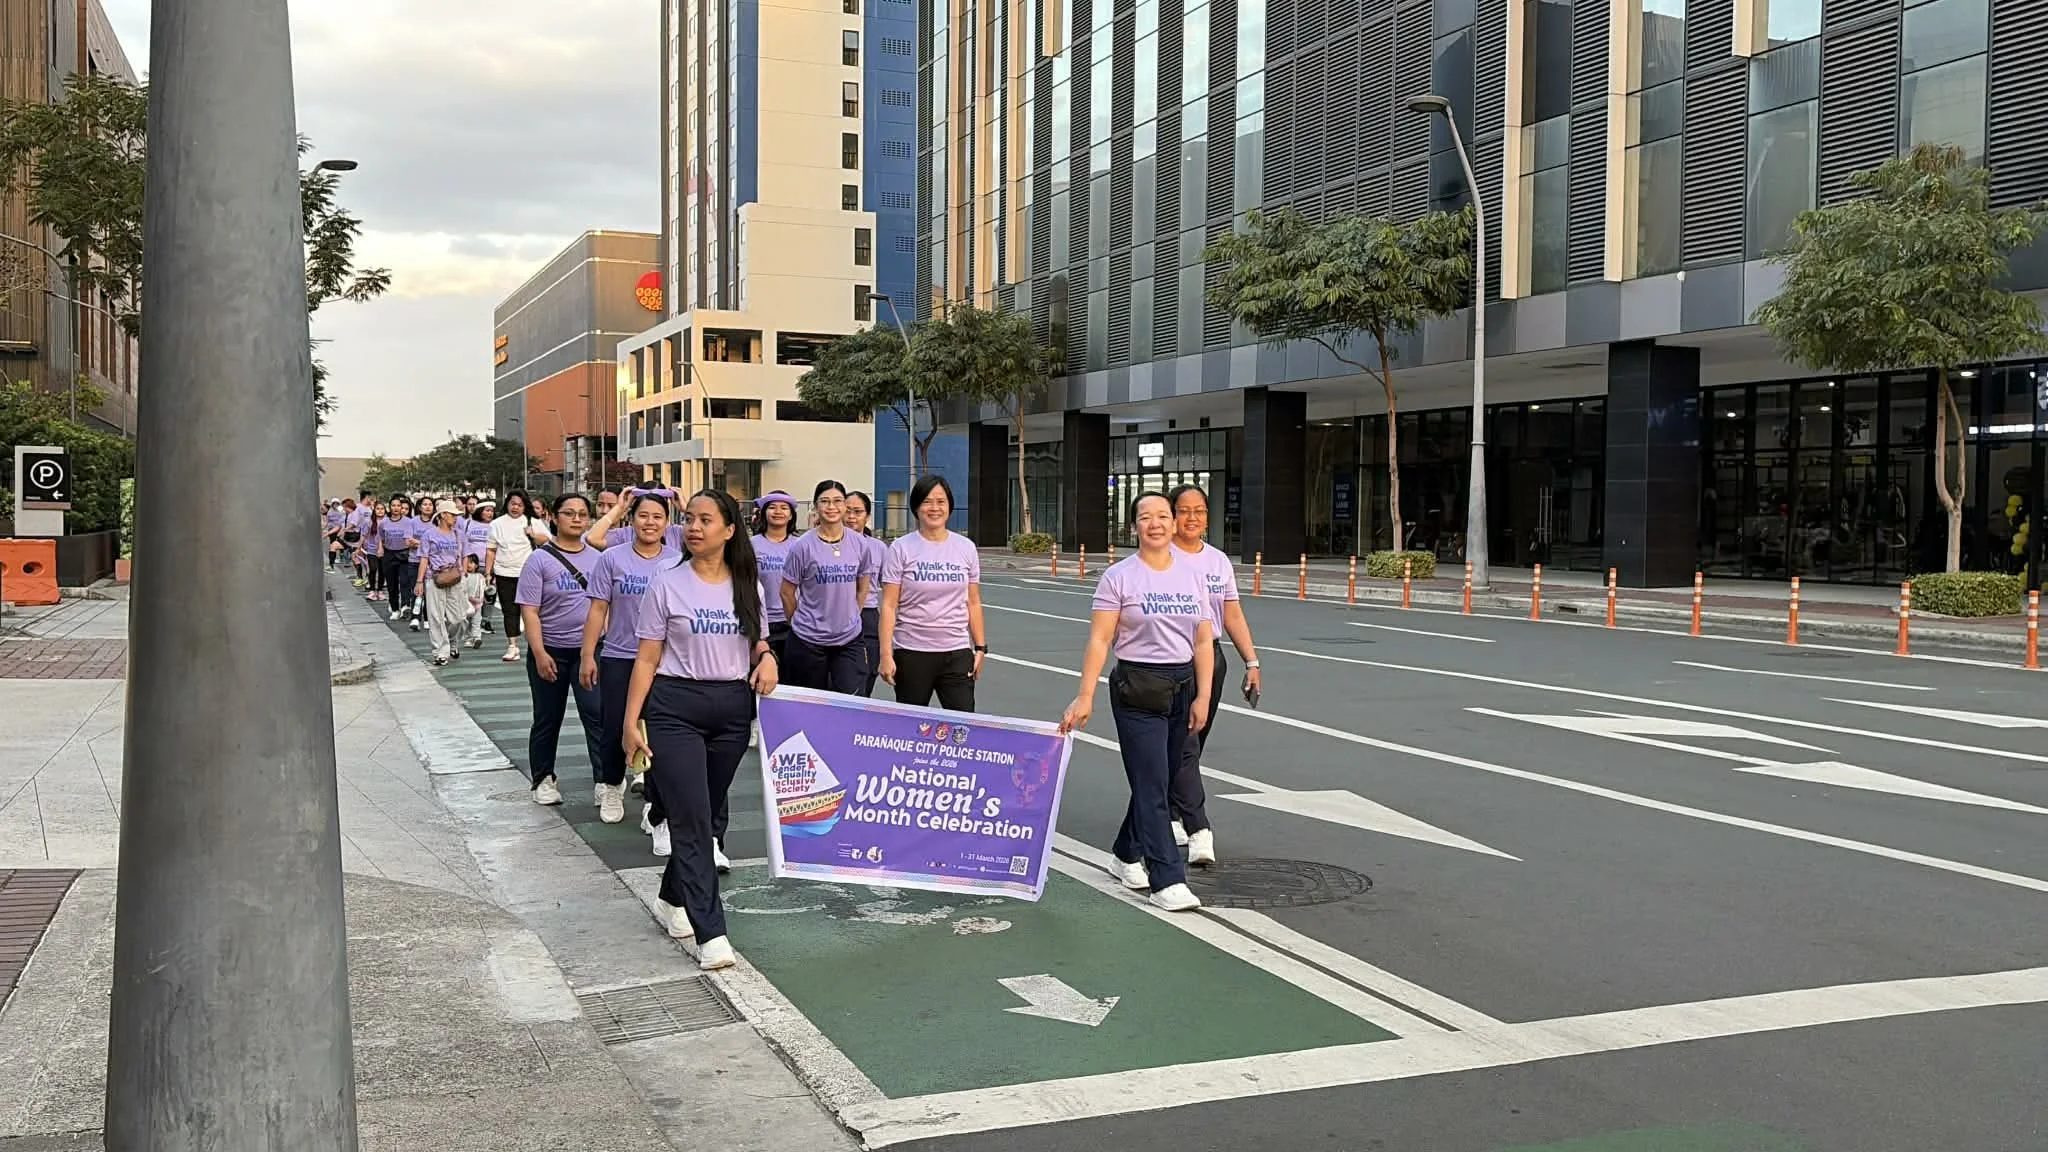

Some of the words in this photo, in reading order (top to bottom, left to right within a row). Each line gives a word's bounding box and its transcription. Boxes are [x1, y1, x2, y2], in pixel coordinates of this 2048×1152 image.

[40, 466, 54, 483] P
[817, 564, 841, 574] Walk
[843, 564, 857, 573] for
[916, 561, 945, 571] Walk
[947, 562, 961, 571] for
[913, 571, 965, 582] Women
[1206, 573, 1221, 582] for
[1144, 592, 1174, 602] Walk
[1176, 593, 1194, 602] for
[695, 608, 730, 619] Walk
[1141, 602, 1200, 615] Women
[854, 734, 914, 753] PARAÑAQUE
[915, 742, 937, 756] CITY
[939, 745, 974, 760] POLICE
[975, 750, 1015, 765] STATION
[779, 753, 807, 767] WE
[772, 764, 807, 773] Gender
[778, 770, 817, 781] Equality
[891, 764, 976, 790] National
[772, 778, 816, 787] Inclusive
[776, 785, 811, 794] Society
[856, 774, 1001, 817] Women's
[844, 804, 912, 826] Month
[916, 812, 1033, 840] Celebration
